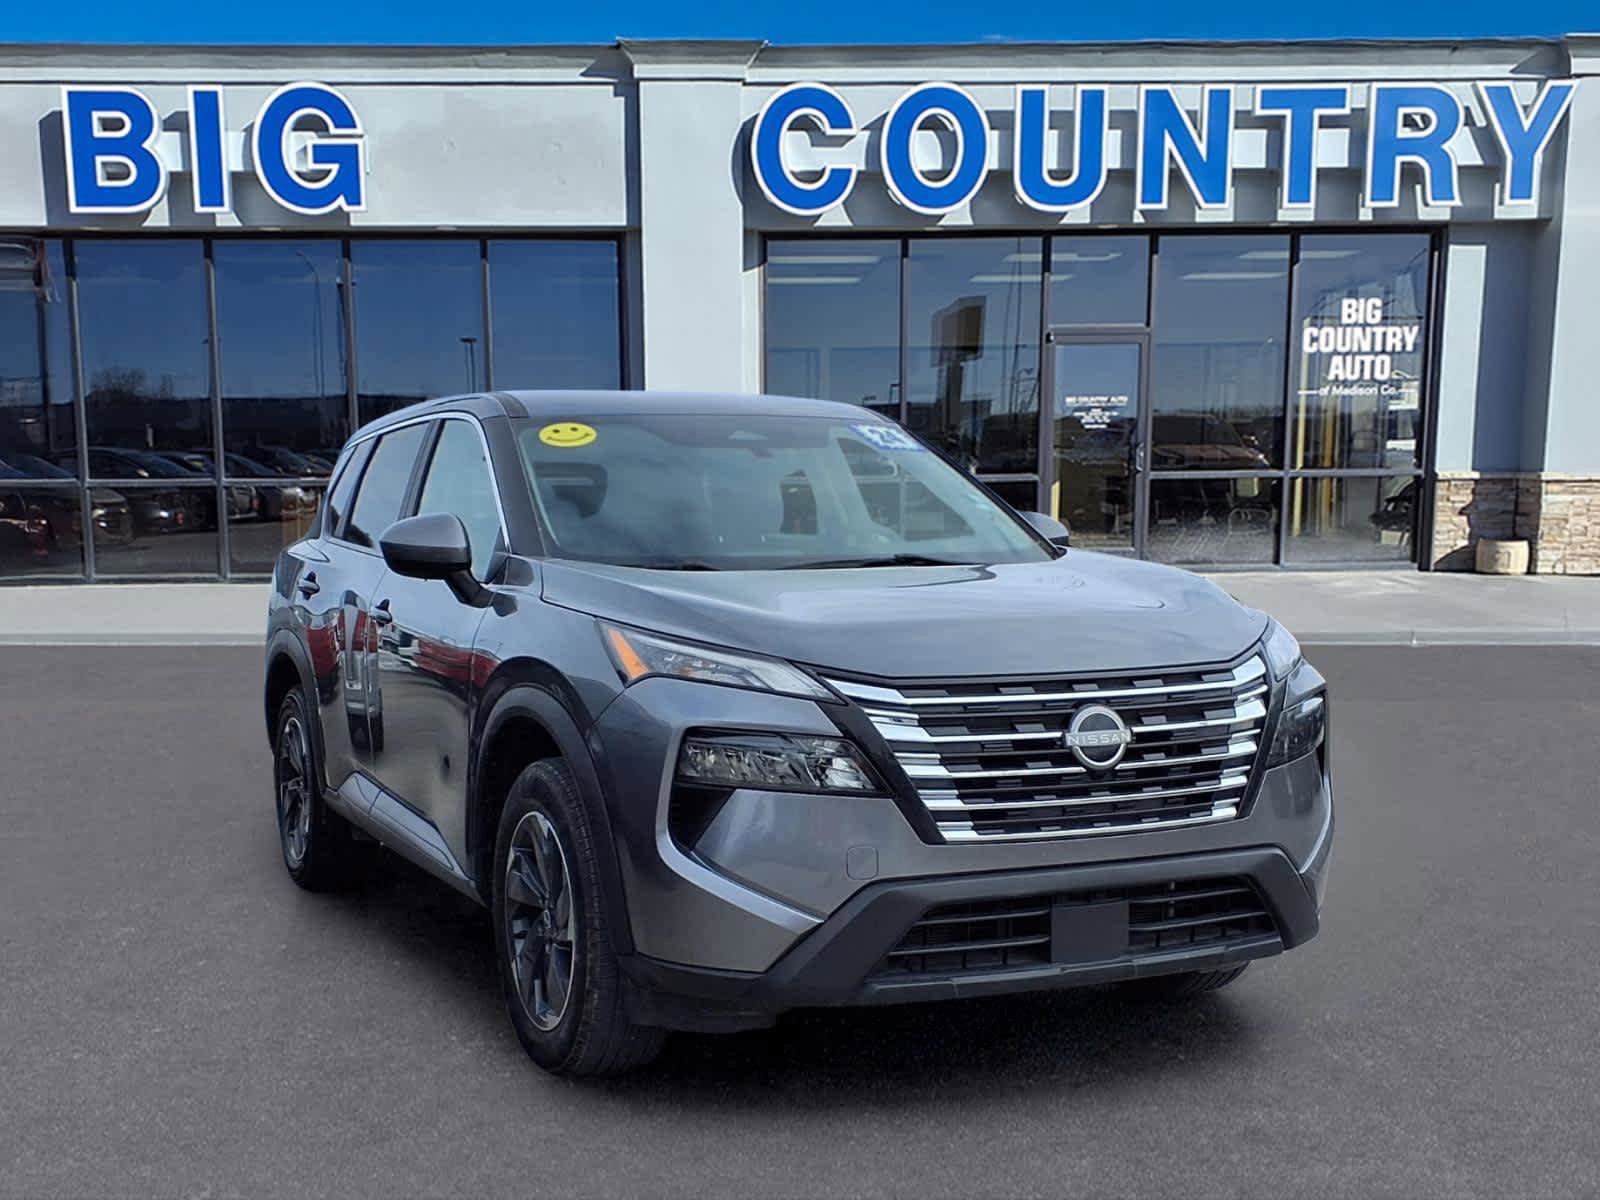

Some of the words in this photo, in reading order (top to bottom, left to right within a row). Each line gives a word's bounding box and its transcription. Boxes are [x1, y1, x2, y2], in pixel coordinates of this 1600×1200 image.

[61, 82, 367, 214] BIG
[751, 82, 1575, 215] COUNTRY
[1341, 297, 1382, 324] BIG
[1303, 326, 1419, 353] COUNTRY
[1327, 354, 1391, 380] AUTO
[1332, 384, 1378, 395] Madison
[1067, 733, 1131, 746] NISSAN
